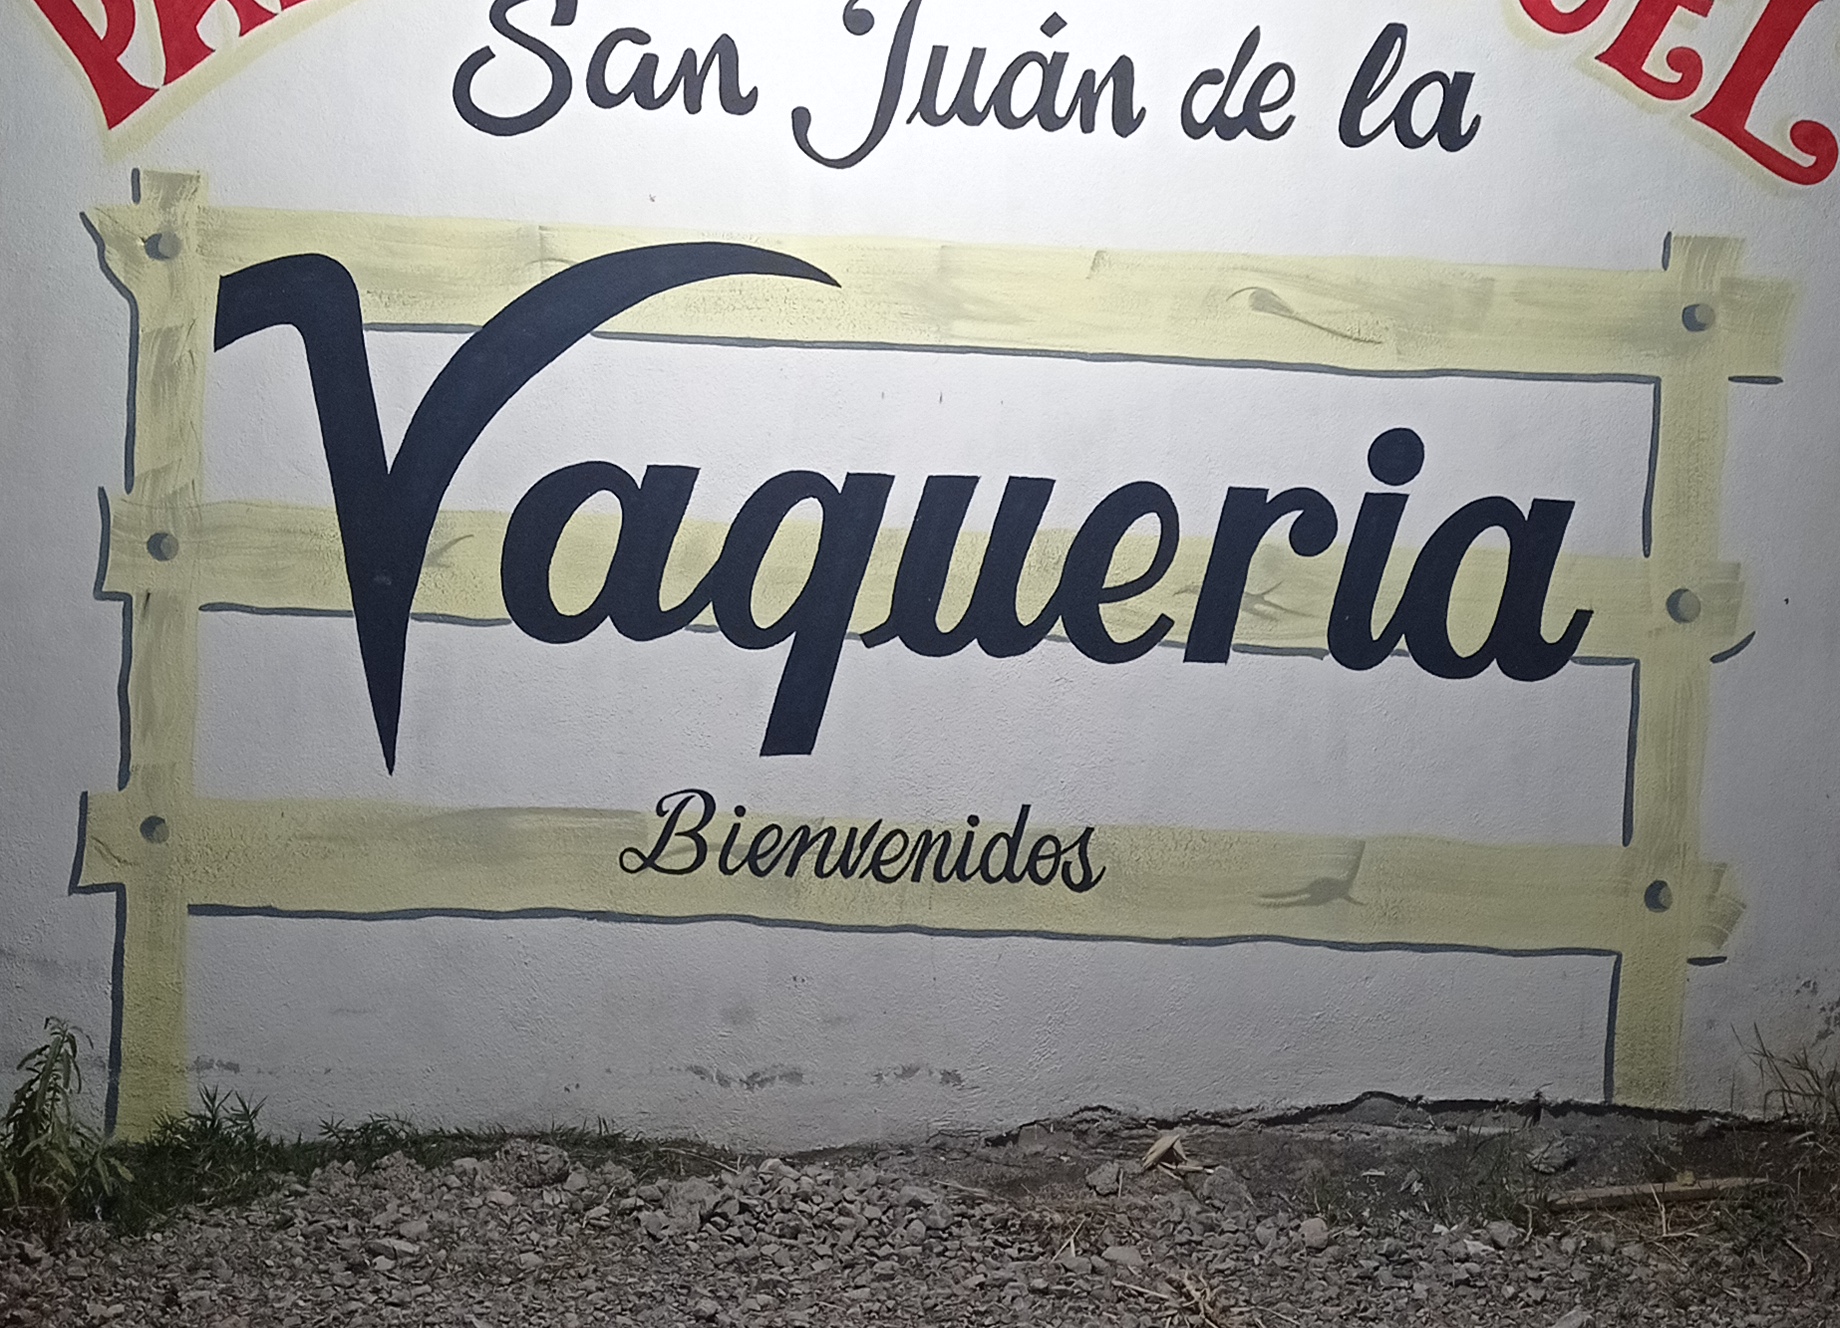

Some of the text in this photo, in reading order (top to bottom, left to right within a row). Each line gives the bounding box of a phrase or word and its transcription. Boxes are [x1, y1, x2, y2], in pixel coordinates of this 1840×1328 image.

[1180, 25, 1296, 140] de
[1338, 22, 1482, 152] la
[213, 241, 1594, 776] Vaqueria
[619, 788, 1107, 893] Bienvenidos
